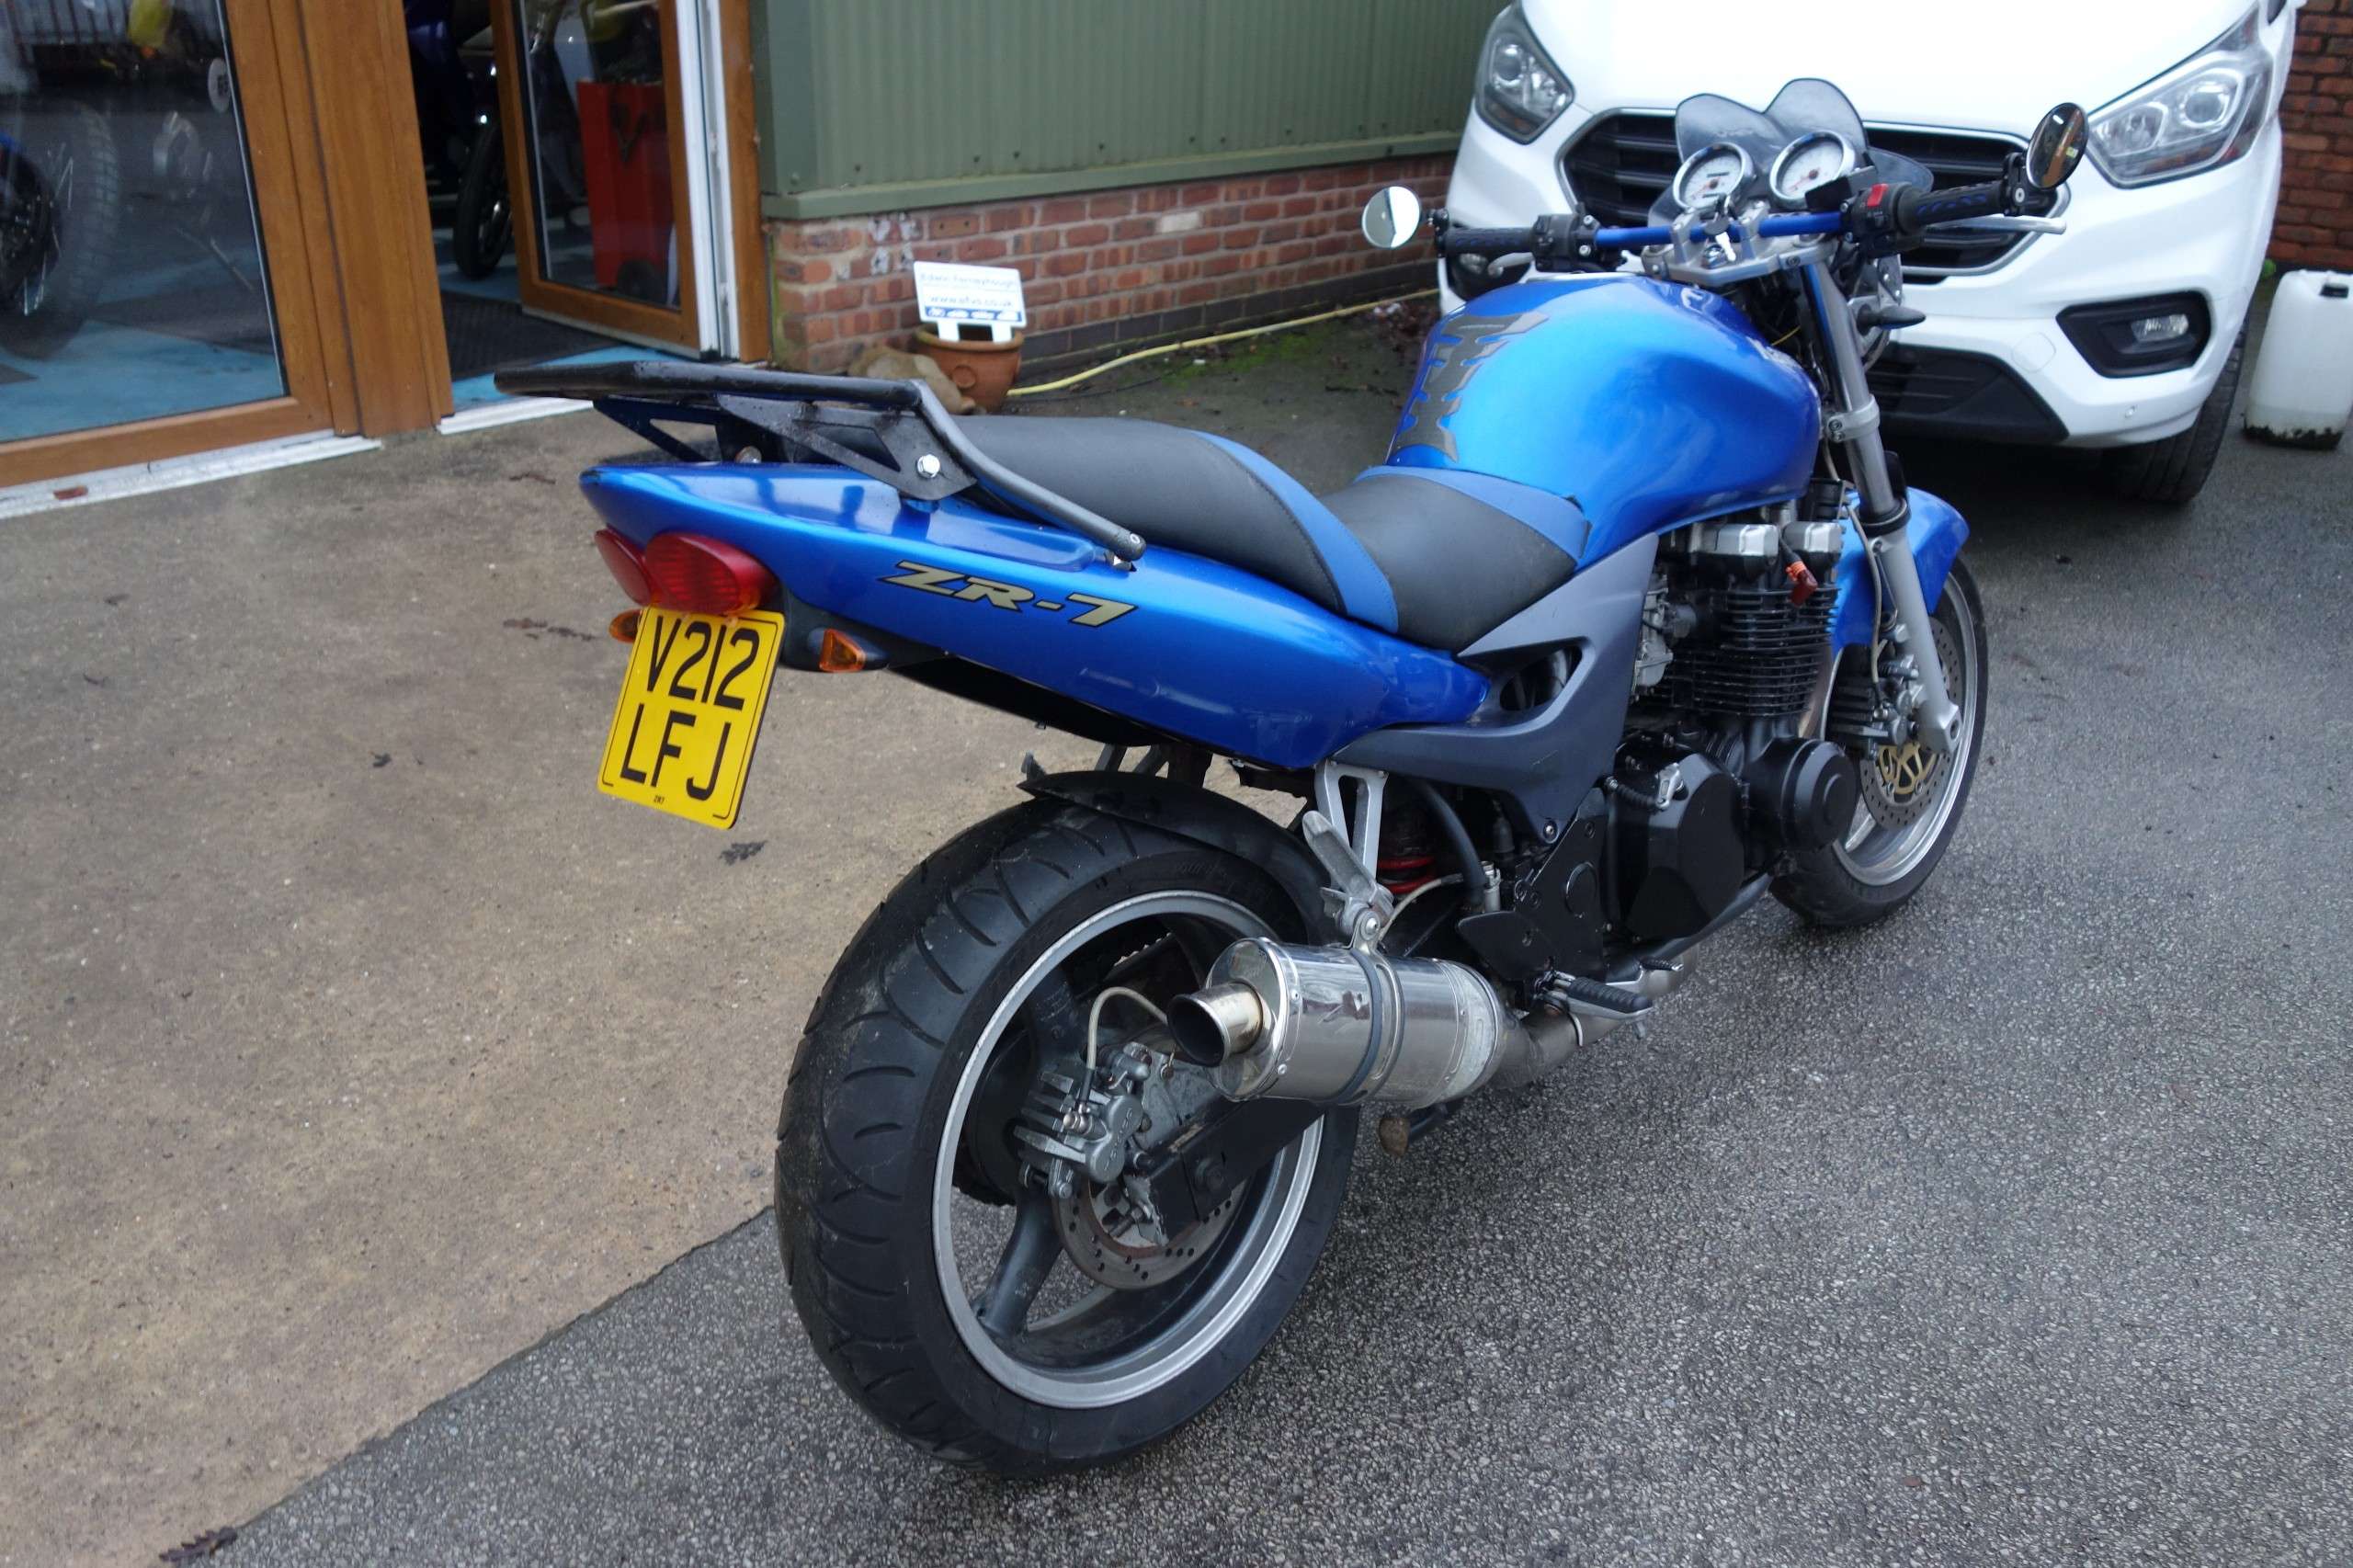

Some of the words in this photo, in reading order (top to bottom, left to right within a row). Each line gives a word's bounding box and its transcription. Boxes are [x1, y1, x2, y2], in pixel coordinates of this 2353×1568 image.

[877, 559, 1139, 628] ZR-7
[646, 615, 760, 710] V212
[620, 702, 732, 801] LFJ
